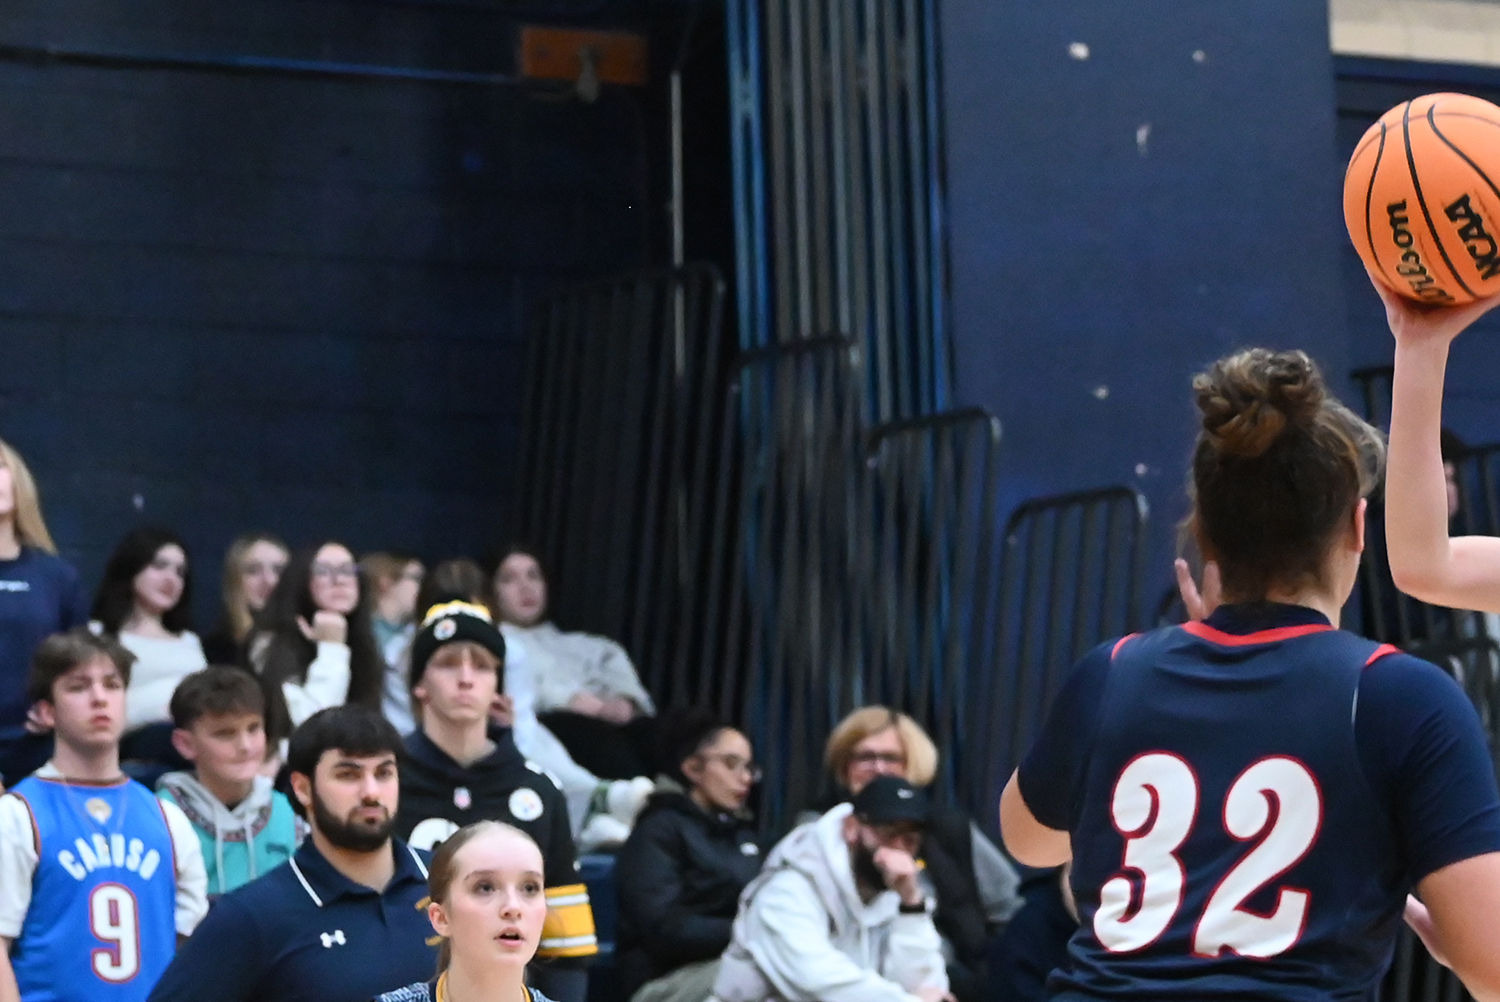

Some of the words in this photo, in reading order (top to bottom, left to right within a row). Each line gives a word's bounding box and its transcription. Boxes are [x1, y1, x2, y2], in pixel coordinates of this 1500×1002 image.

[58, 833, 160, 881] CARUSO
[1093, 749, 1324, 960] 32
[88, 881, 141, 984] 9
